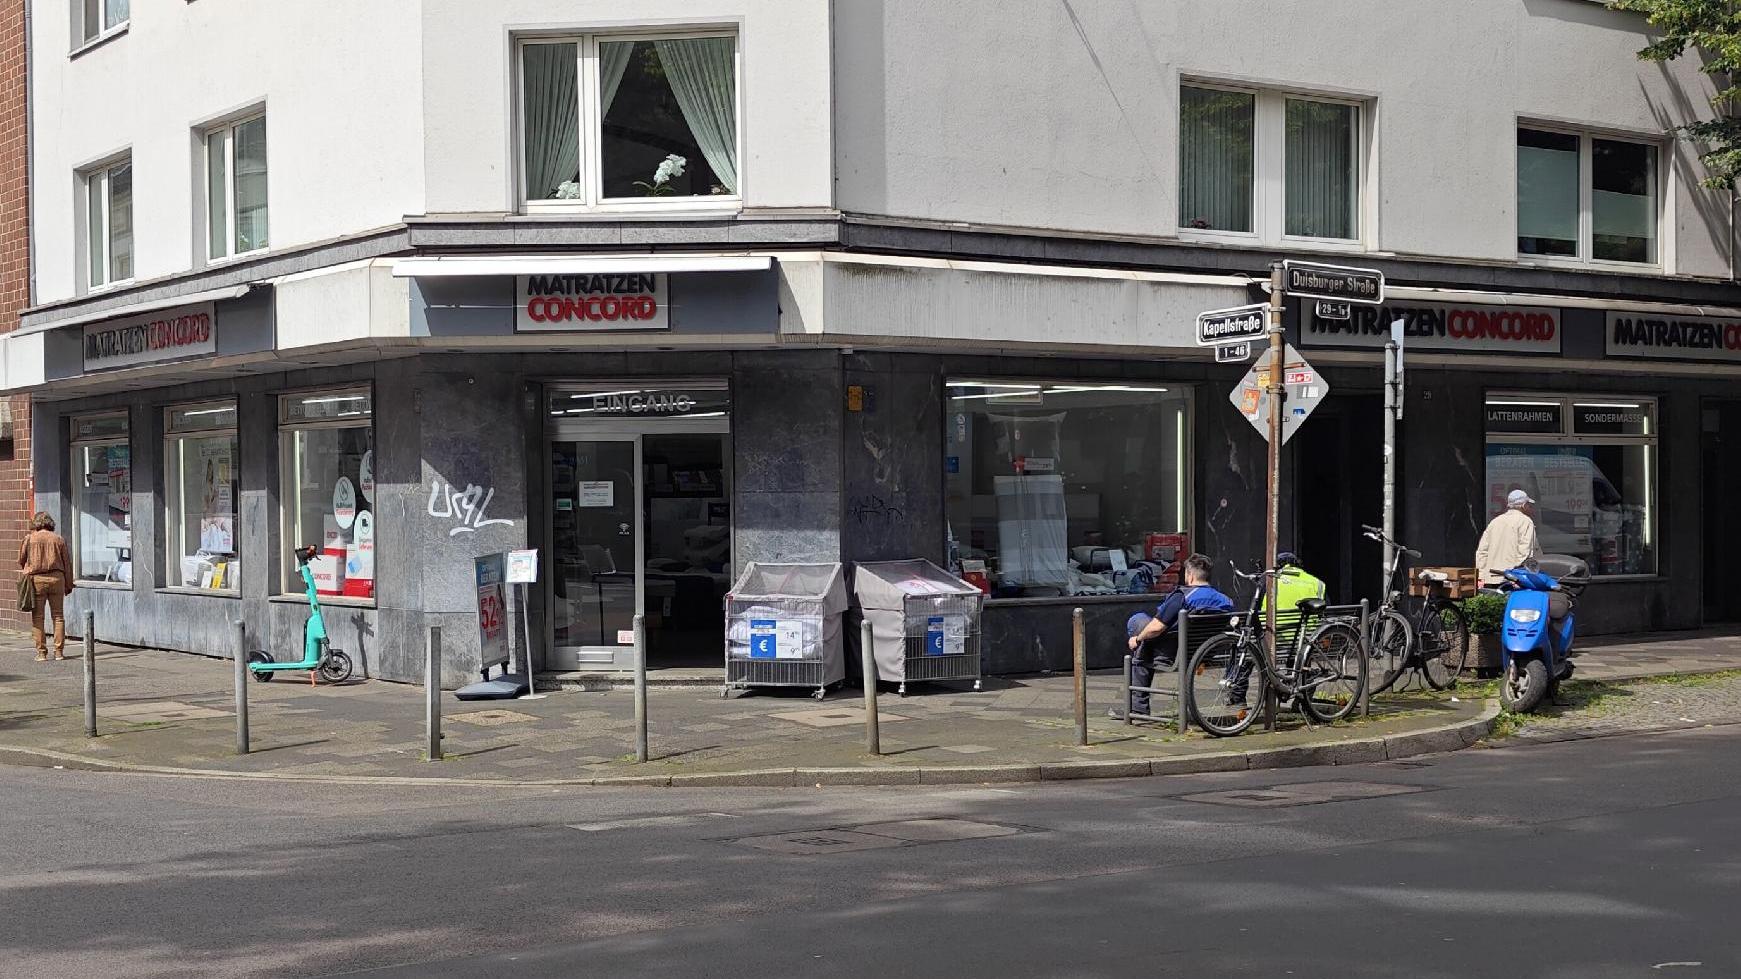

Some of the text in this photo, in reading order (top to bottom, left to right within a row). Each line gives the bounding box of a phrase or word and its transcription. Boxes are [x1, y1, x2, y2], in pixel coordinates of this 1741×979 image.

[527, 273, 656, 296] MATRATZEN
[1293, 271, 1375, 294] Duisburger Straße
[527, 296, 657, 323] CONCORD
[86, 313, 210, 360] MATRATZEN CONCORD
[1203, 315, 1261, 337] Kapellstraße
[1447, 309, 1555, 341] CONCORD
[1613, 318, 1723, 349] MATRATZEN
[592, 394, 692, 413] EINGANG
[1487, 411, 1553, 422] LATTENRAHMEN
